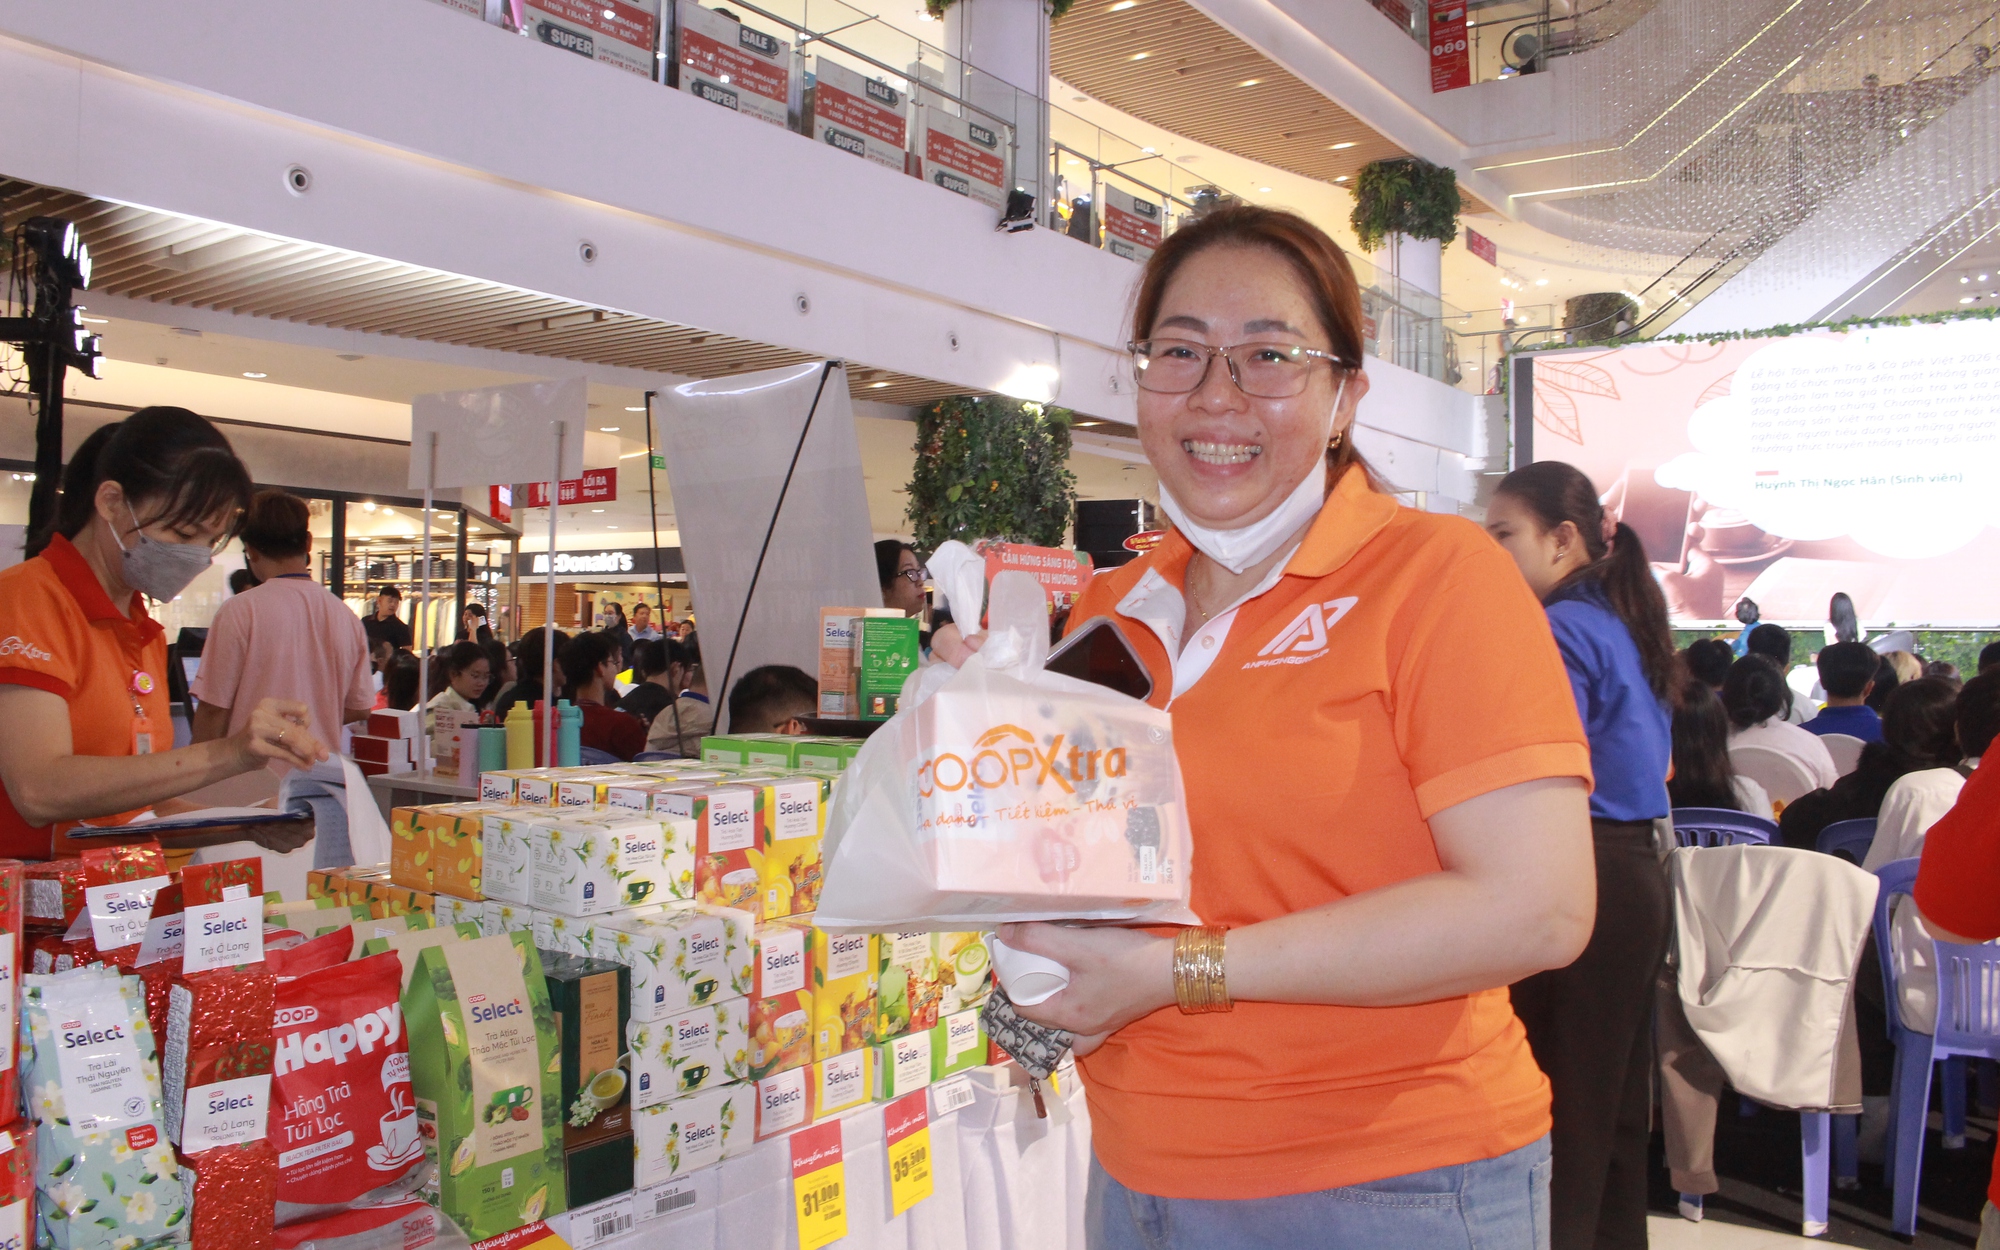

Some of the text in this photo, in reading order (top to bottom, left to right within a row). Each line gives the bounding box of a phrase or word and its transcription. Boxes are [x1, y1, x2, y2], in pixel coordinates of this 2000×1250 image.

[550, 28, 593, 55] SUPER
[741, 30, 768, 50] SALE
[703, 85, 737, 109] SUPER
[868, 82, 891, 99] SALE
[834, 133, 864, 154] SUPER
[971, 126, 990, 143] SALE
[943, 176, 968, 196] SUPER
[595, 476, 607, 486] RA
[1755, 472, 1963, 491] Huỳnh Thị Ngọc Hân (Sinh viên)
[583, 487, 608, 498] Way out
[1020, 553, 1041, 566] HỨNG
[1043, 554, 1062, 568] SÁNG
[1063, 558, 1077, 570] TẠO
[780, 800, 813, 815] Select
[996, 807, 1030, 822] Tiết
[1036, 803, 1069, 822] kiệm
[1122, 796, 1138, 811] vị
[713, 810, 749, 826] Select
[624, 840, 656, 854] Select
[203, 912, 219, 920] COOP
[109, 922, 125, 934] Trà
[203, 917, 248, 936] Select
[200, 946, 213, 956] Trà
[227, 942, 250, 951] Long
[691, 937, 719, 954] Select
[832, 937, 864, 955] Select
[767, 951, 800, 971] Select
[469, 994, 486, 1003] COOP
[471, 998, 523, 1024] Select
[61, 1021, 82, 1030] COOP
[485, 1028, 518, 1041] Trà Atiso
[678, 1023, 710, 1041] Select
[64, 1024, 124, 1049] Select
[274, 1002, 400, 1077] Happy
[471, 1045, 491, 1056] Thảo
[510, 1038, 521, 1047] Túi
[522, 1035, 535, 1045] Lọc
[88, 1058, 117, 1072] Trà Lài
[389, 1056, 403, 1068] 100
[76, 1065, 131, 1085] Thái Nguyên
[90, 1082, 122, 1094] JASMINE TEA
[208, 1094, 254, 1115] Select
[284, 1081, 351, 1121] Hồng Trà
[765, 1087, 801, 1110] Select
[203, 1125, 218, 1134] Trà
[231, 1119, 255, 1129] Long
[284, 1112, 344, 1143] Túi Lọc
[685, 1124, 715, 1144] Select
[132, 1138, 154, 1147] Nguyên
[211, 1133, 234, 1141] OOLONG
[286, 1138, 343, 1163] BLACK TEA FILTER BAG
[893, 1146, 926, 1182] 35.500
[803, 1182, 840, 1217] 31.000
[402, 1214, 434, 1235] Save
